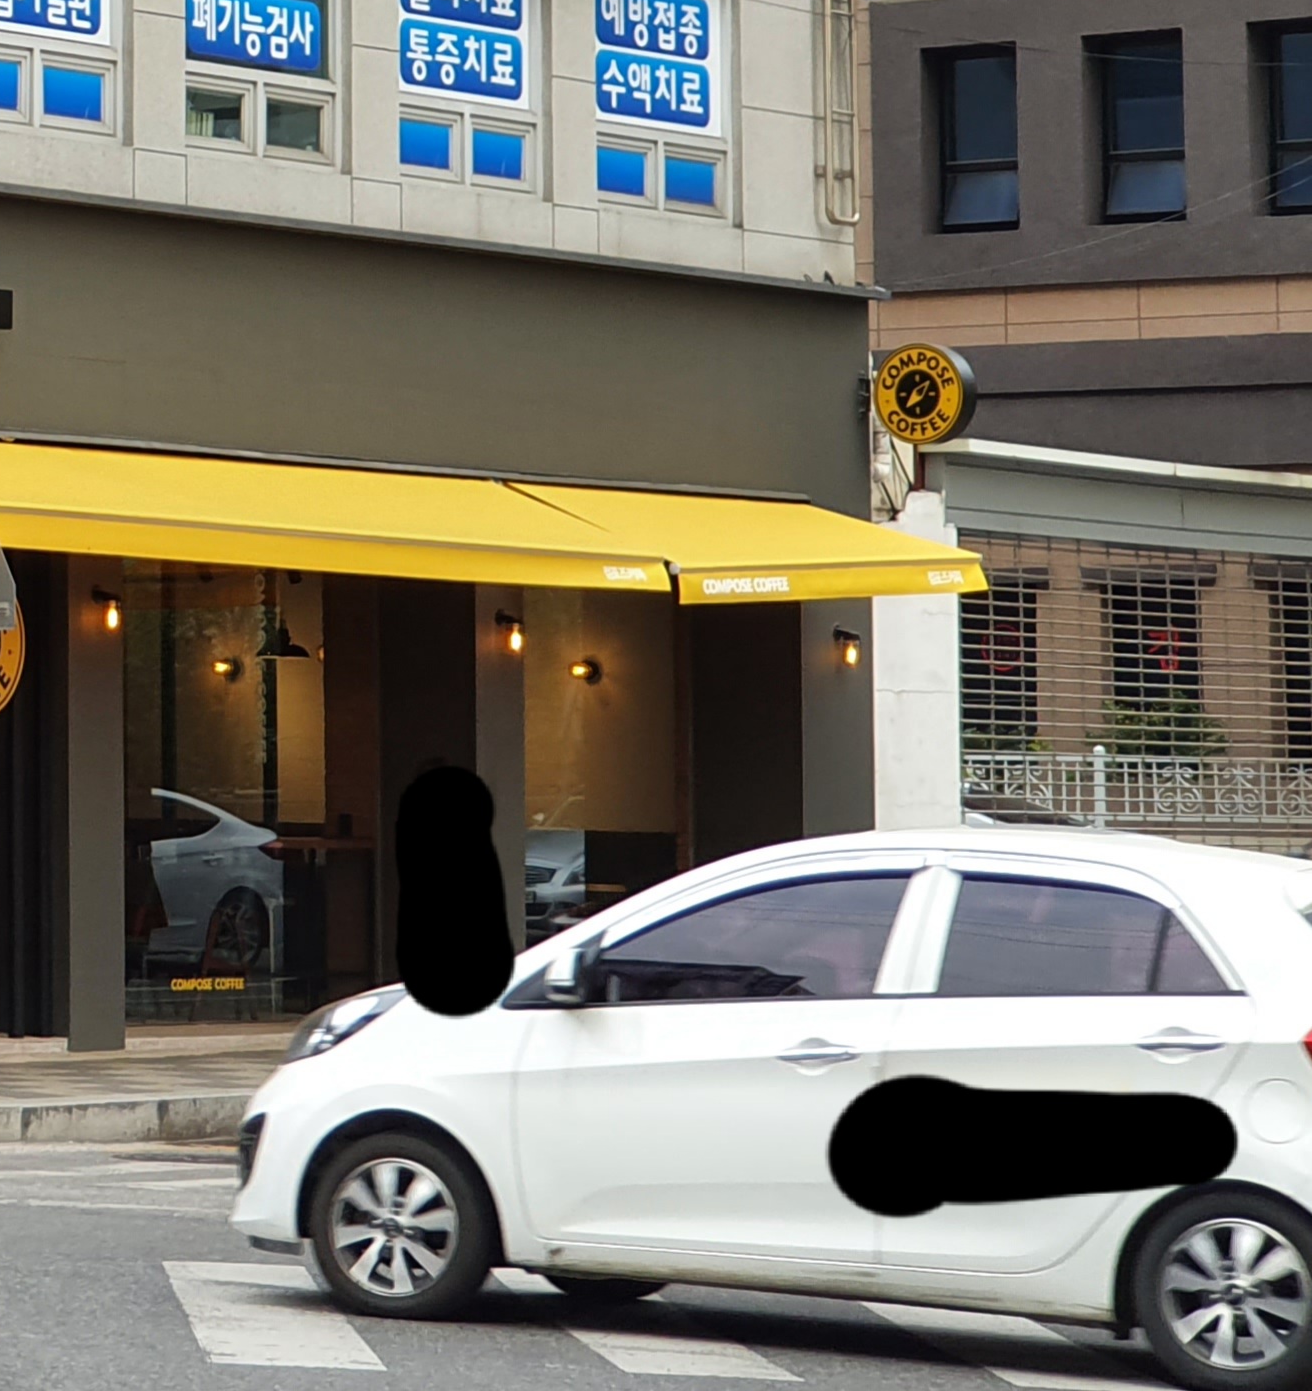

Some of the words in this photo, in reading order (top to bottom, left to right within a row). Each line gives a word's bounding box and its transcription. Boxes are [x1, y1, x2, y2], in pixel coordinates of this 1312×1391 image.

[406, 27, 517, 88] 통증치료
[601, 58, 705, 116] 수액치료
[882, 351, 955, 391] COMPOSE
[887, 409, 952, 437] COFFEE
[703, 578, 753, 595] COMPOSE
[754, 576, 790, 594] COFFEE
[171, 977, 213, 992] COMPOSE
[214, 976, 245, 991] COFFEE
